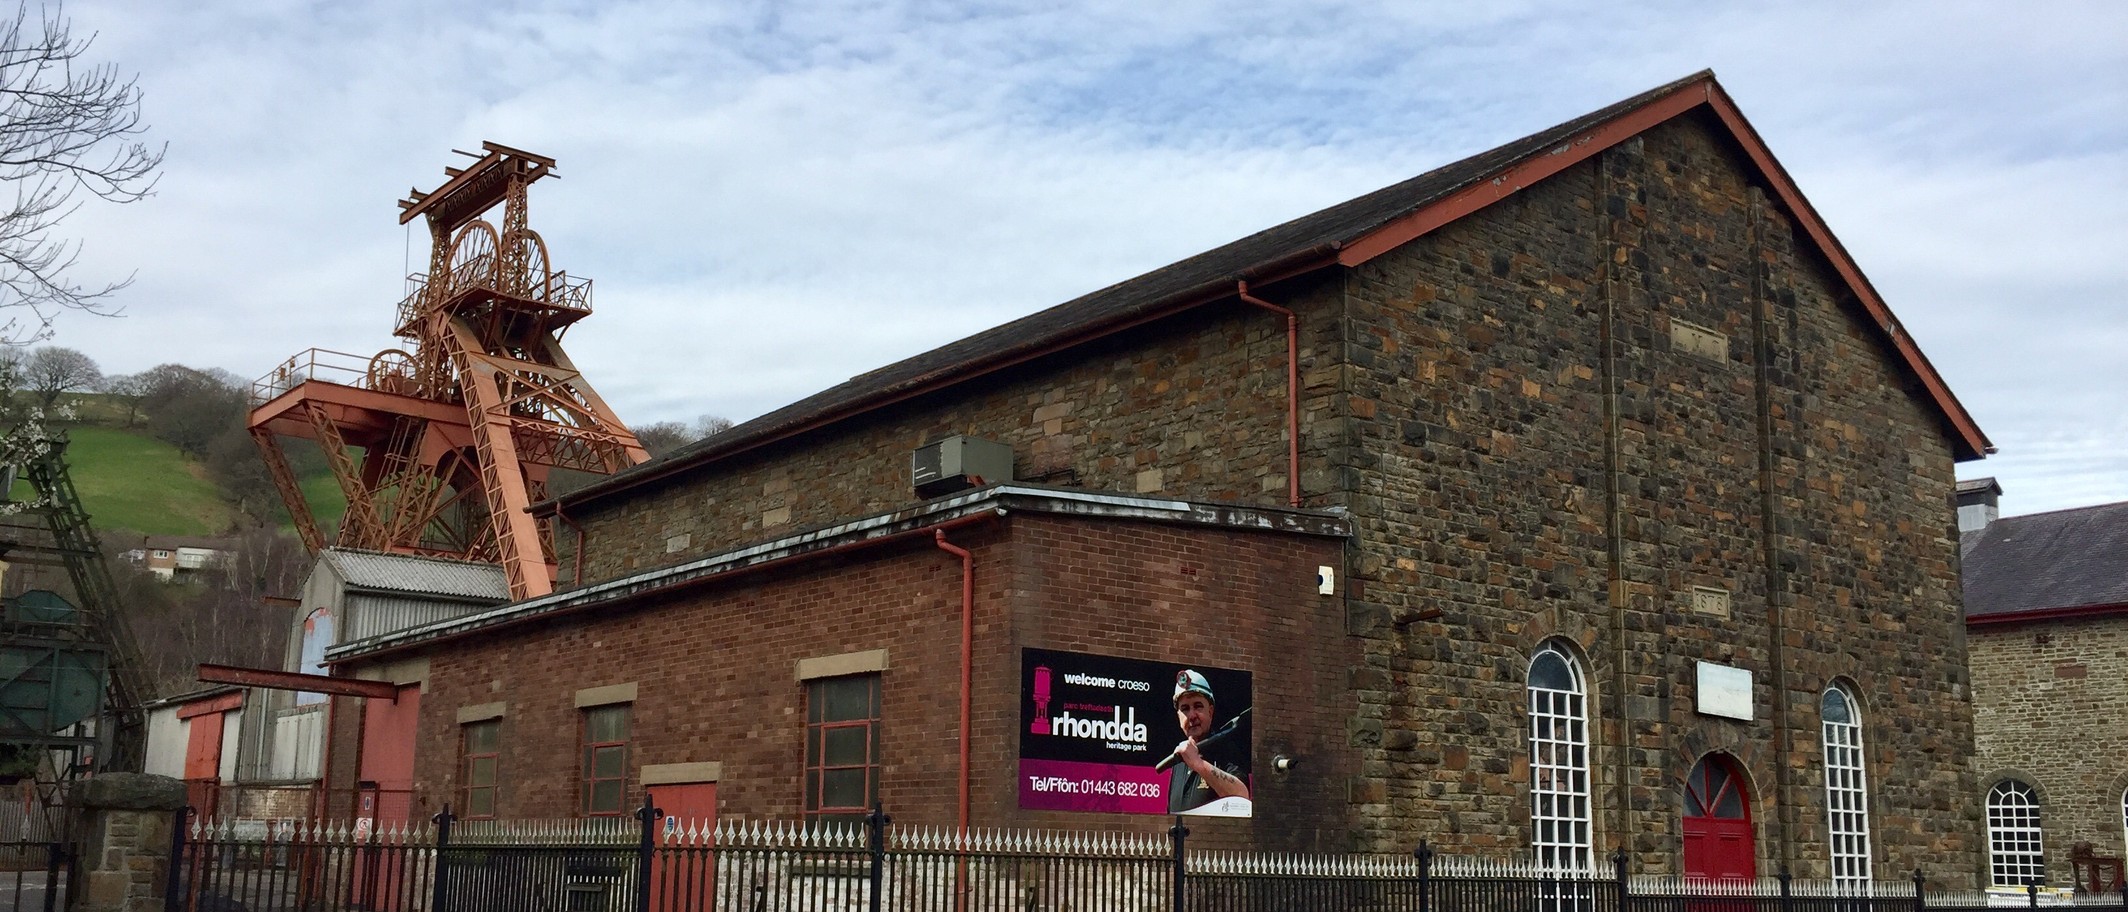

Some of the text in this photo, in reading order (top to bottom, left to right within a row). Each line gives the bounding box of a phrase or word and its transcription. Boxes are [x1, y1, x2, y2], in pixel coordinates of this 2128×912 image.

[1064, 672, 1150, 692] welcome croeso
[1063, 702, 1079, 711] parc
[1052, 705, 1147, 742] rhondda
[1106, 741, 1147, 752] heritage park
[1029, 776, 1160, 798] Tel/Ffôn: 01443 682 036
